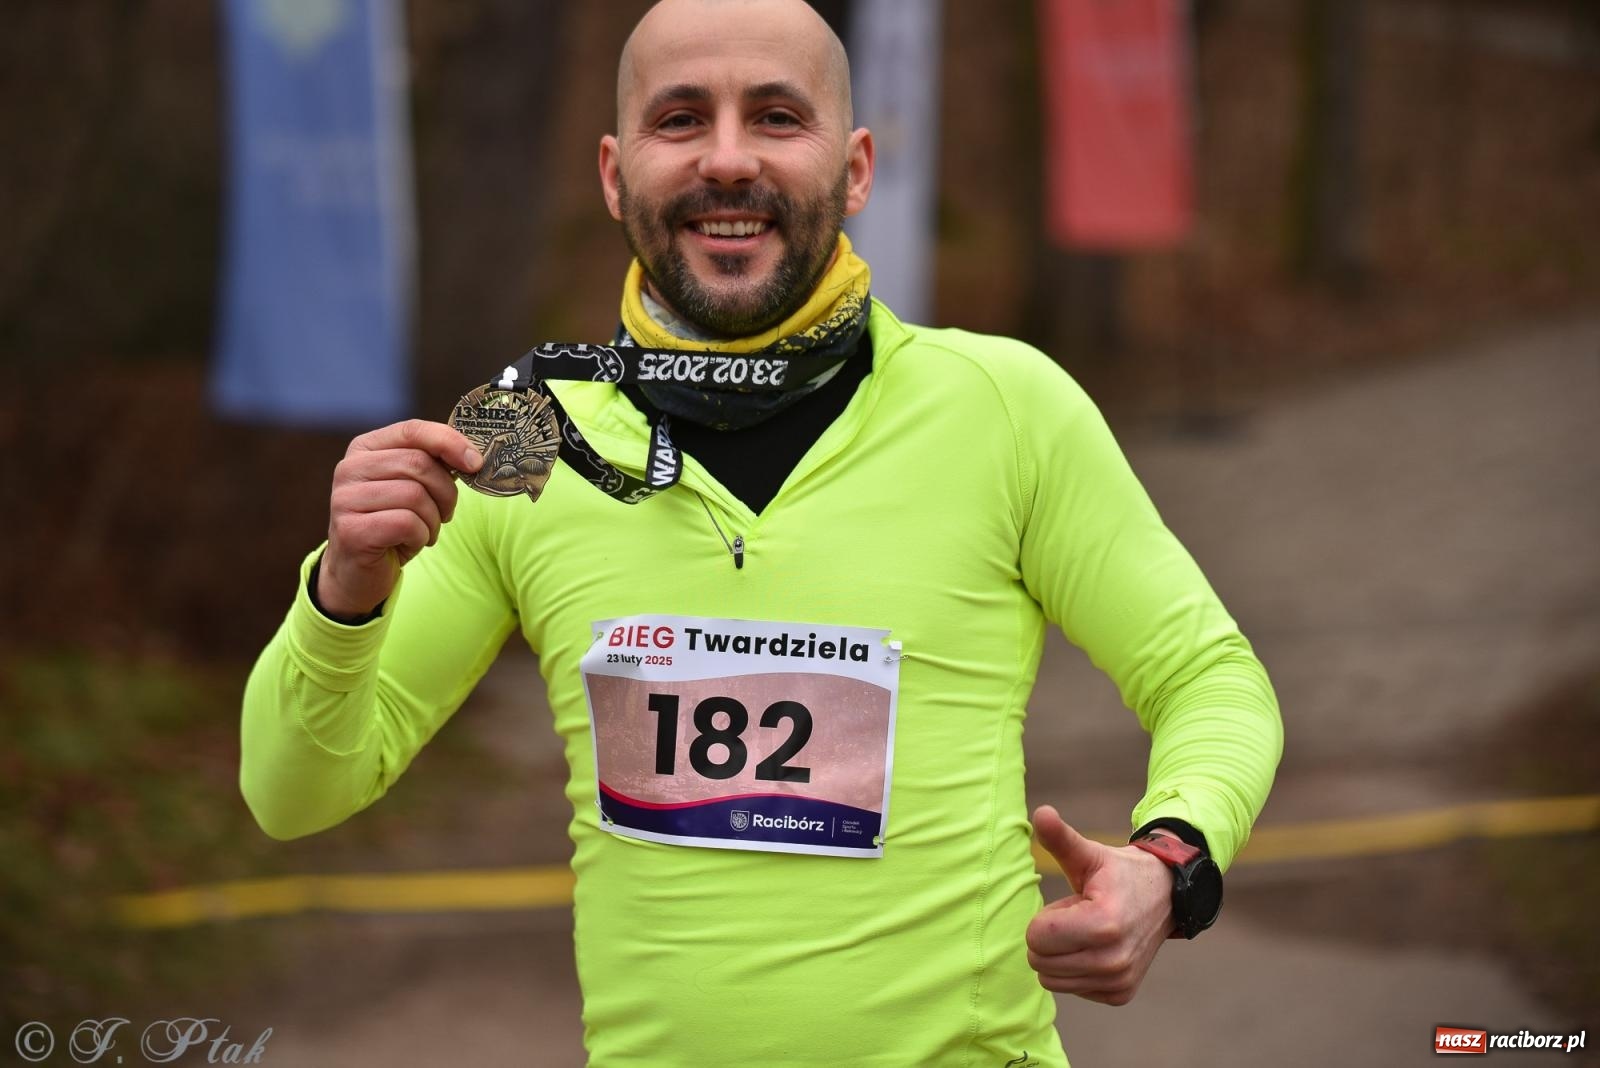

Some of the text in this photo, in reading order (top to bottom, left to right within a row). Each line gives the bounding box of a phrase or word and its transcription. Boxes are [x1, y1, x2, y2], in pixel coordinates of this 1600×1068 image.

[637, 352, 789, 386] 23.02.2025
[455, 405, 517, 421] 13 BIEG
[608, 624, 869, 662] BIEG Twardziela
[606, 653, 673, 667] 23 luty 2025
[648, 692, 814, 784] 182
[752, 813, 825, 832] Racibórz
